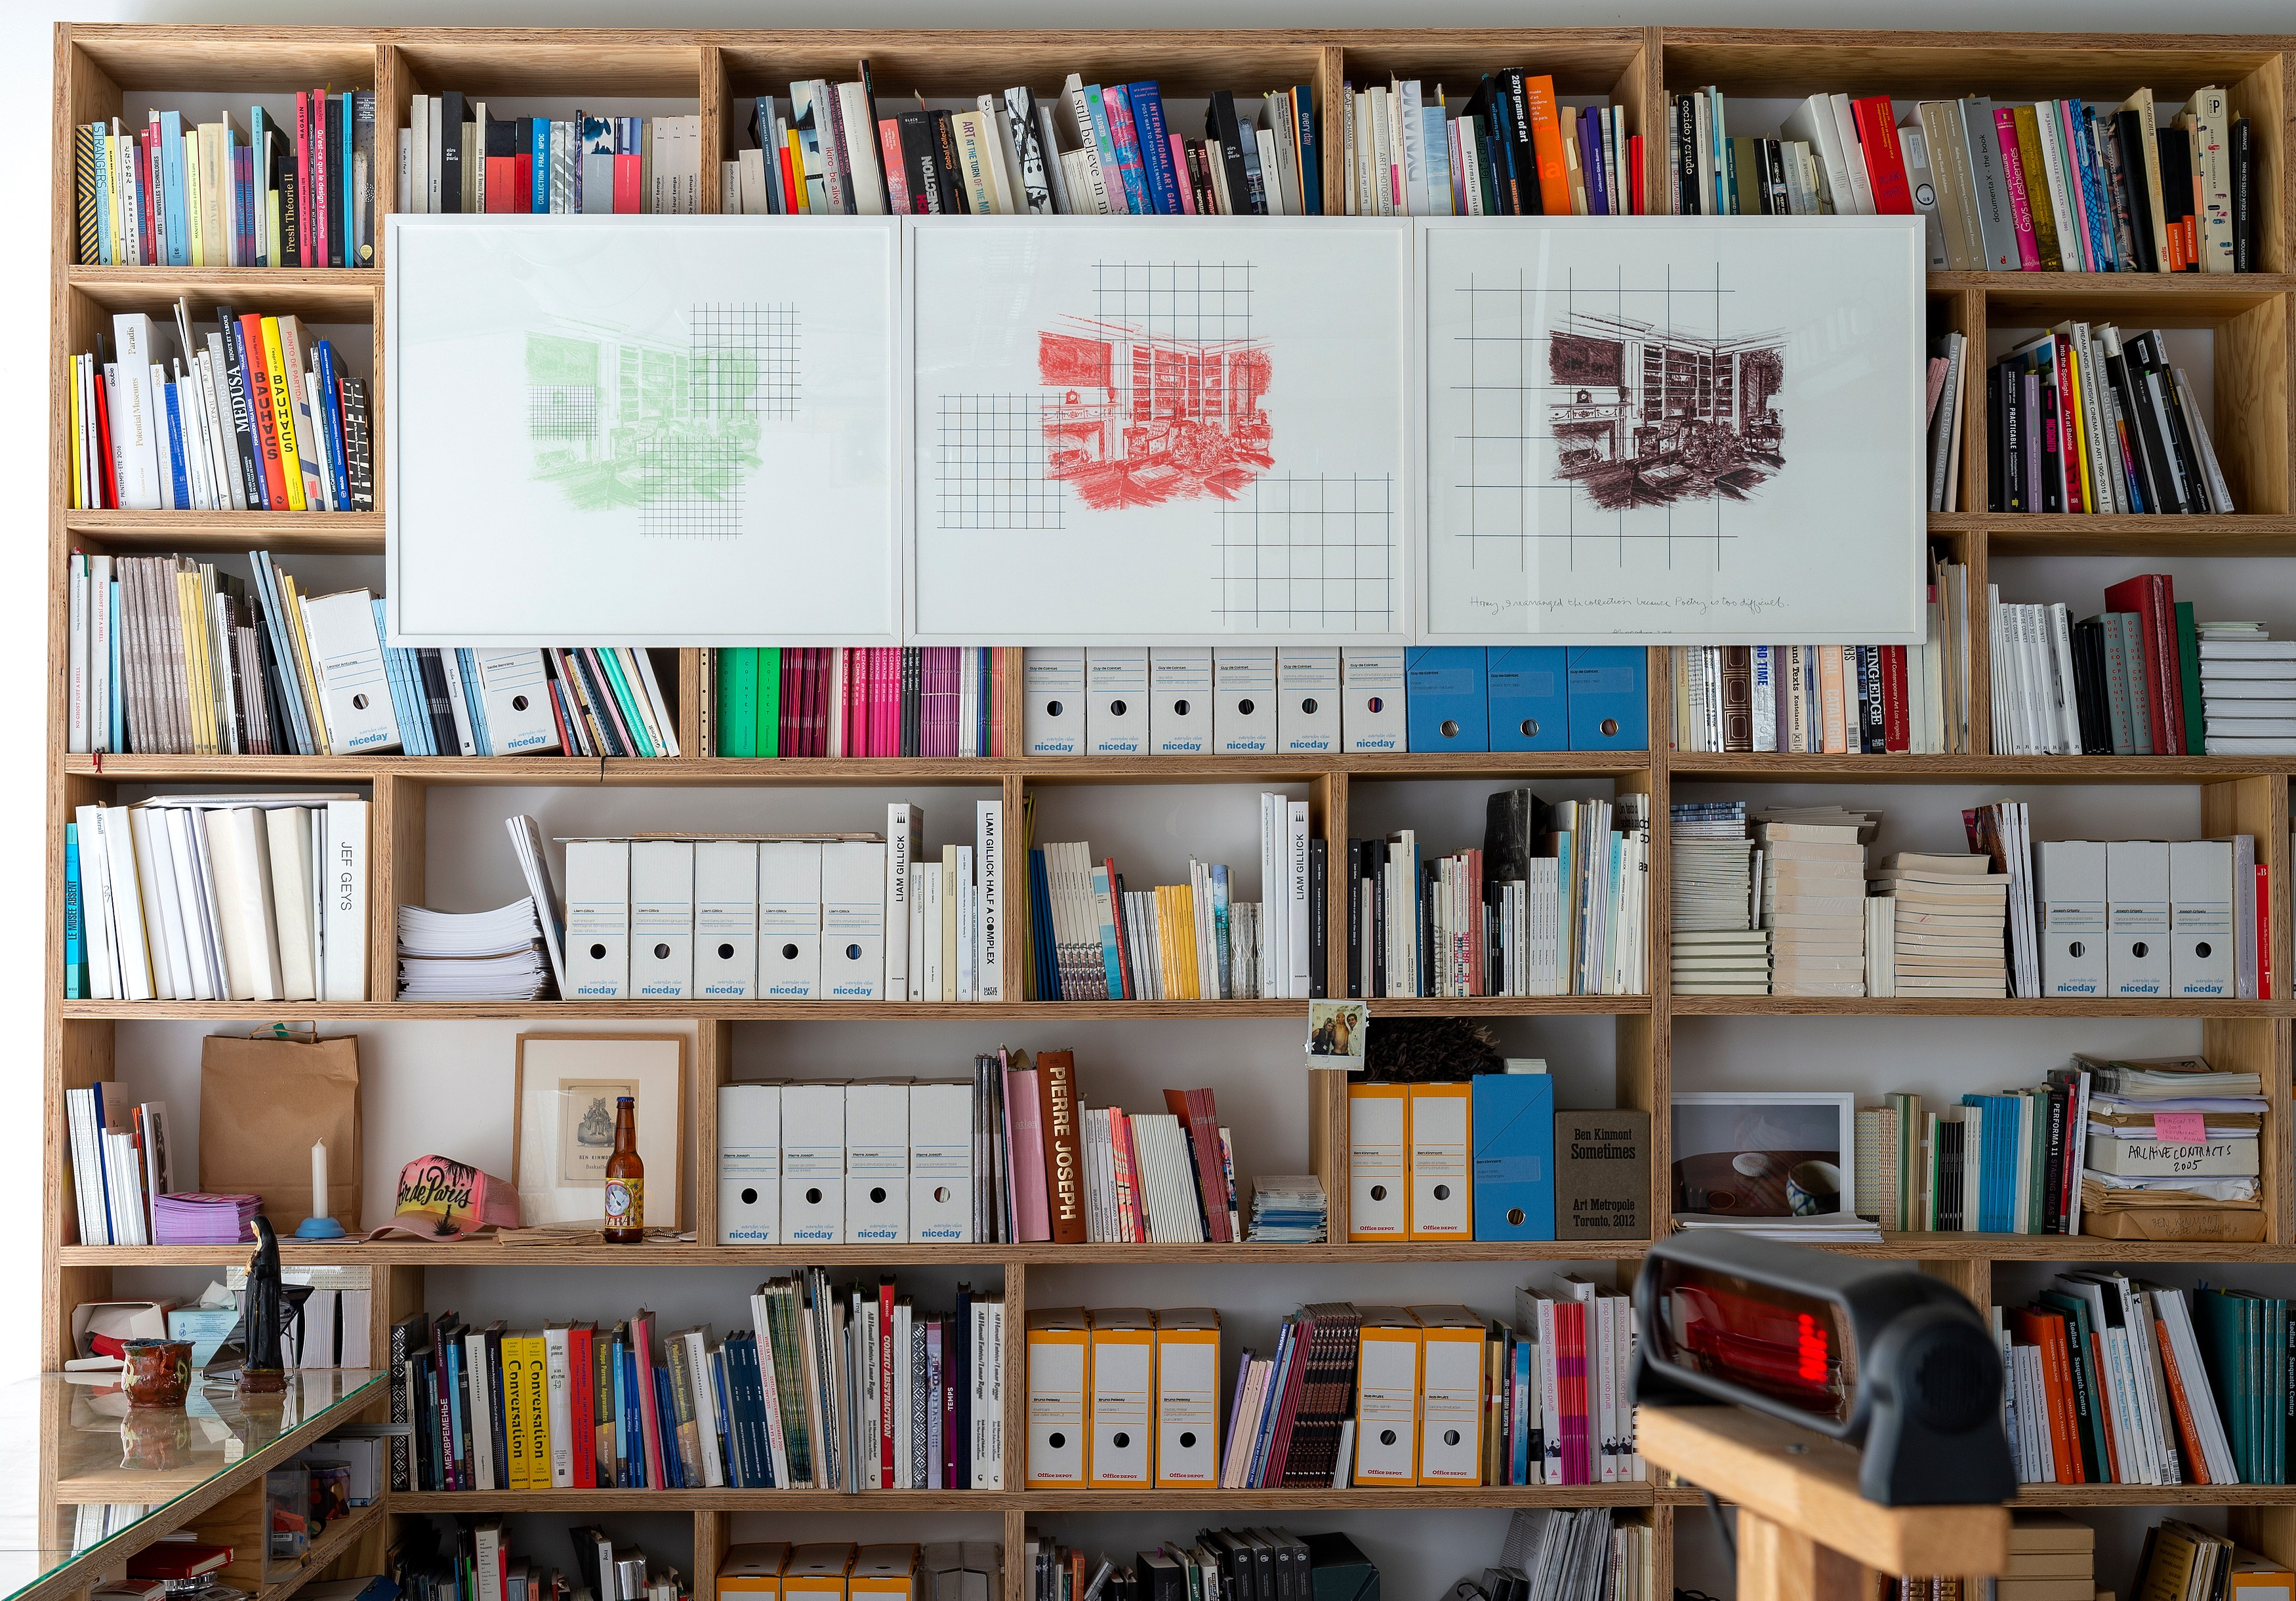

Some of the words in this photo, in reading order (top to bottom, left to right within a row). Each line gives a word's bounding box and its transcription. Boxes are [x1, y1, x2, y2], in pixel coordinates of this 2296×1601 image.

[1511, 75, 1521, 93] 2870
[1513, 96, 1523, 119] grams
[1302, 112, 1311, 132] every
[1683, 100, 1692, 136] cocido
[1303, 134, 1312, 146] day
[1404, 81, 1420, 182] DYNAMO
[1519, 130, 1528, 142] art
[1075, 99, 1090, 123] still
[1084, 127, 1099, 176] believe
[1095, 182, 1105, 196] in
[1149, 102, 1168, 169] INTERNATIONAL
[1162, 169, 1172, 188] ART
[1978, 134, 1988, 153] book
[93, 126, 107, 189] STRANGERS
[1685, 144, 1694, 174] crudo
[829, 172, 836, 183] be
[1467, 151, 1476, 193] performative
[285, 182, 295, 224] Théorie
[831, 186, 840, 205] alive
[1988, 182, 2000, 223] documenta
[287, 226, 296, 253] Fresh
[127, 327, 136, 355] Paradis
[286, 331, 295, 355] PUNTO
[290, 357, 297, 367] DE
[292, 369, 302, 402] PARTIDA
[229, 365, 249, 433] MEDUSA
[255, 373, 277, 460] BAUHAUS
[274, 375, 293, 453] BAUHAUS
[2046, 420, 2056, 452] INCOGNITO
[1469, 596, 1504, 616] Honey,
[1513, 598, 1564, 611] rearranged
[1568, 598, 1584, 607] the
[1584, 598, 1632, 607] collection
[1636, 597, 1671, 607] because
[1675, 596, 1707, 615] Poetry
[1710, 598, 1719, 607] is
[1740, 596, 1790, 615] difficult.
[1757, 662, 1767, 687] TIME
[1870, 683, 1882, 725] EDGE
[1825, 690, 1840, 751] CATALOGUE
[348, 732, 387, 748] niceday
[508, 736, 547, 749] niceday
[1035, 742, 1075, 752] niceday
[1098, 742, 1138, 752] niceday
[1162, 742, 1202, 752] niceday
[1226, 740, 1266, 751] niceday
[1290, 740, 1330, 750] niceday
[1356, 739, 1396, 748] niceday
[341, 841, 352, 868] JEF
[896, 835, 905, 874] GILLICK
[68, 880, 77, 906] ABSENT
[340, 873, 352, 911] GEYS
[67, 908, 77, 931] MUSÉE
[68, 932, 77, 941] LE
[578, 985, 618, 996] niceday
[642, 985, 682, 996] niceday
[705, 985, 745, 996] niceday
[769, 985, 810, 996] niceday
[833, 985, 872, 996] niceday
[2057, 984, 2097, 994] niceday
[2120, 984, 2160, 994] niceday
[2184, 984, 2224, 995] niceday
[1050, 1067, 1070, 1137] PIERRE
[1015, 1119, 1037, 1129] atlas
[2051, 1103, 2060, 1145] PERFORMA
[1574, 1129, 1591, 1141] Ben
[1593, 1128, 1631, 1141] Kinmont
[1570, 1143, 1636, 1160] Sometimes
[2128, 1145, 2173, 1160] ARCHIVE
[2173, 1145, 2231, 1160] CONTRACTS
[2173, 1160, 2201, 1171] 2005
[426, 1165, 473, 1208] Paris
[1056, 1141, 1076, 1220] JOSEPH
[1573, 1199, 1588, 1211] Art
[1590, 1198, 1635, 1213] Metropole
[1574, 1215, 1610, 1228] Toronto,
[1613, 1215, 1635, 1227] 2012
[729, 1229, 769, 1240] niceday
[793, 1229, 834, 1240] niceday
[857, 1229, 898, 1240] niceday
[922, 1228, 962, 1239] niceday
[2074, 1356, 2084, 1389] Sasquatch
[508, 1360, 525, 1459] Conversation
[529, 1360, 546, 1459] Conversation
[441, 1398, 453, 1469] МЕЖВРЕМЕНЬЕ
